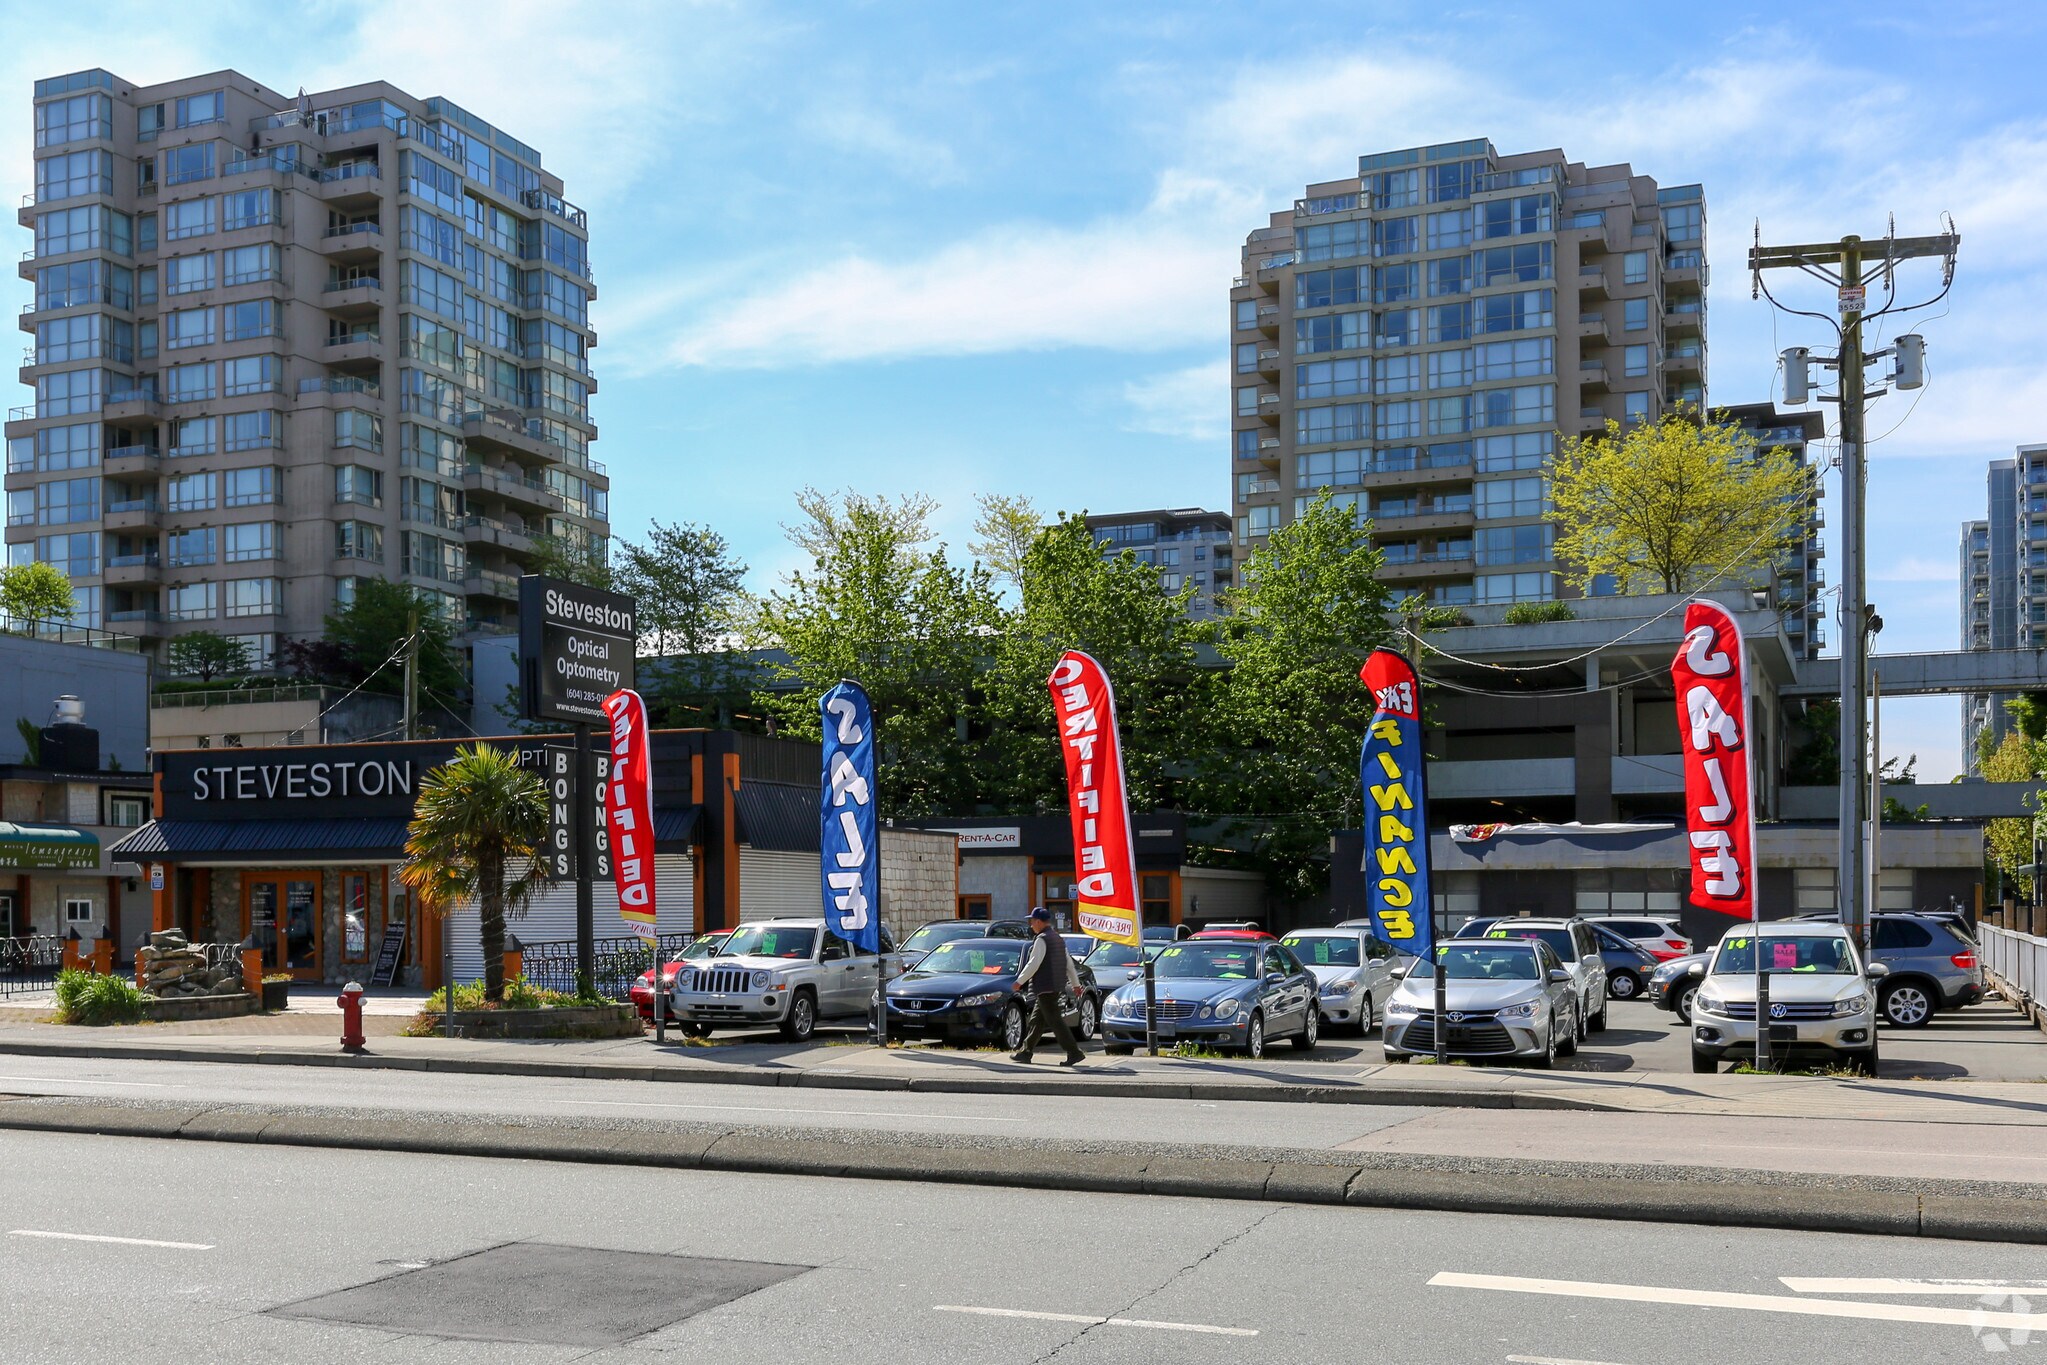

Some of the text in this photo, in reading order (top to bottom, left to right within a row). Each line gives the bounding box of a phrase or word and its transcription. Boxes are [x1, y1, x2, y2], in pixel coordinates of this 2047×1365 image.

[546, 589, 632, 631] Steveston
[568, 636, 609, 660] Optical
[557, 657, 620, 688] Optometry
[566, 688, 610, 703] (604) 285-010
[556, 703, 608, 718] www.stevestonoptic
[508, 749, 548, 767] OPTI
[193, 760, 411, 800] STEVESTON
[555, 753, 569, 875] BONGS
[595, 757, 609, 876] BONGS
[959, 834, 1016, 842] RENT-A-CAR
